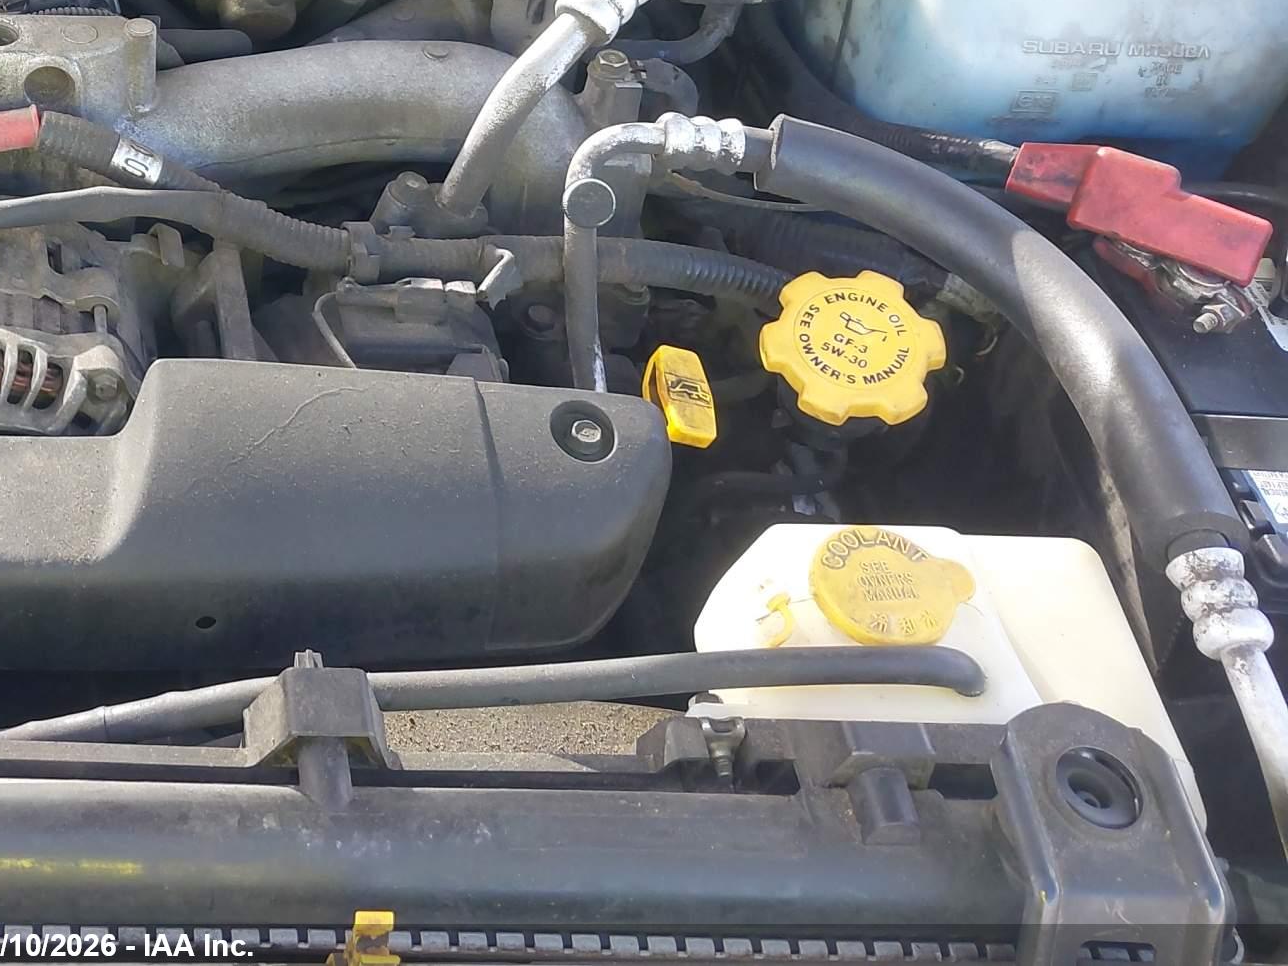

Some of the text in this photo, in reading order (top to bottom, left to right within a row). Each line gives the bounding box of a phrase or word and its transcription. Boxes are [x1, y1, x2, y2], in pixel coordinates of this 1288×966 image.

[1022, 40, 1211, 60] SUBARU MITSUBA
[824, 292, 908, 337] ENGINE OIL
[798, 303, 910, 385] SEE OWNER'S MANUAL
[820, 342, 868, 369] 5W-30
[833, 333, 868, 354] GF-3
[821, 528, 929, 570] COOLANT
[859, 560, 891, 575] SEE
